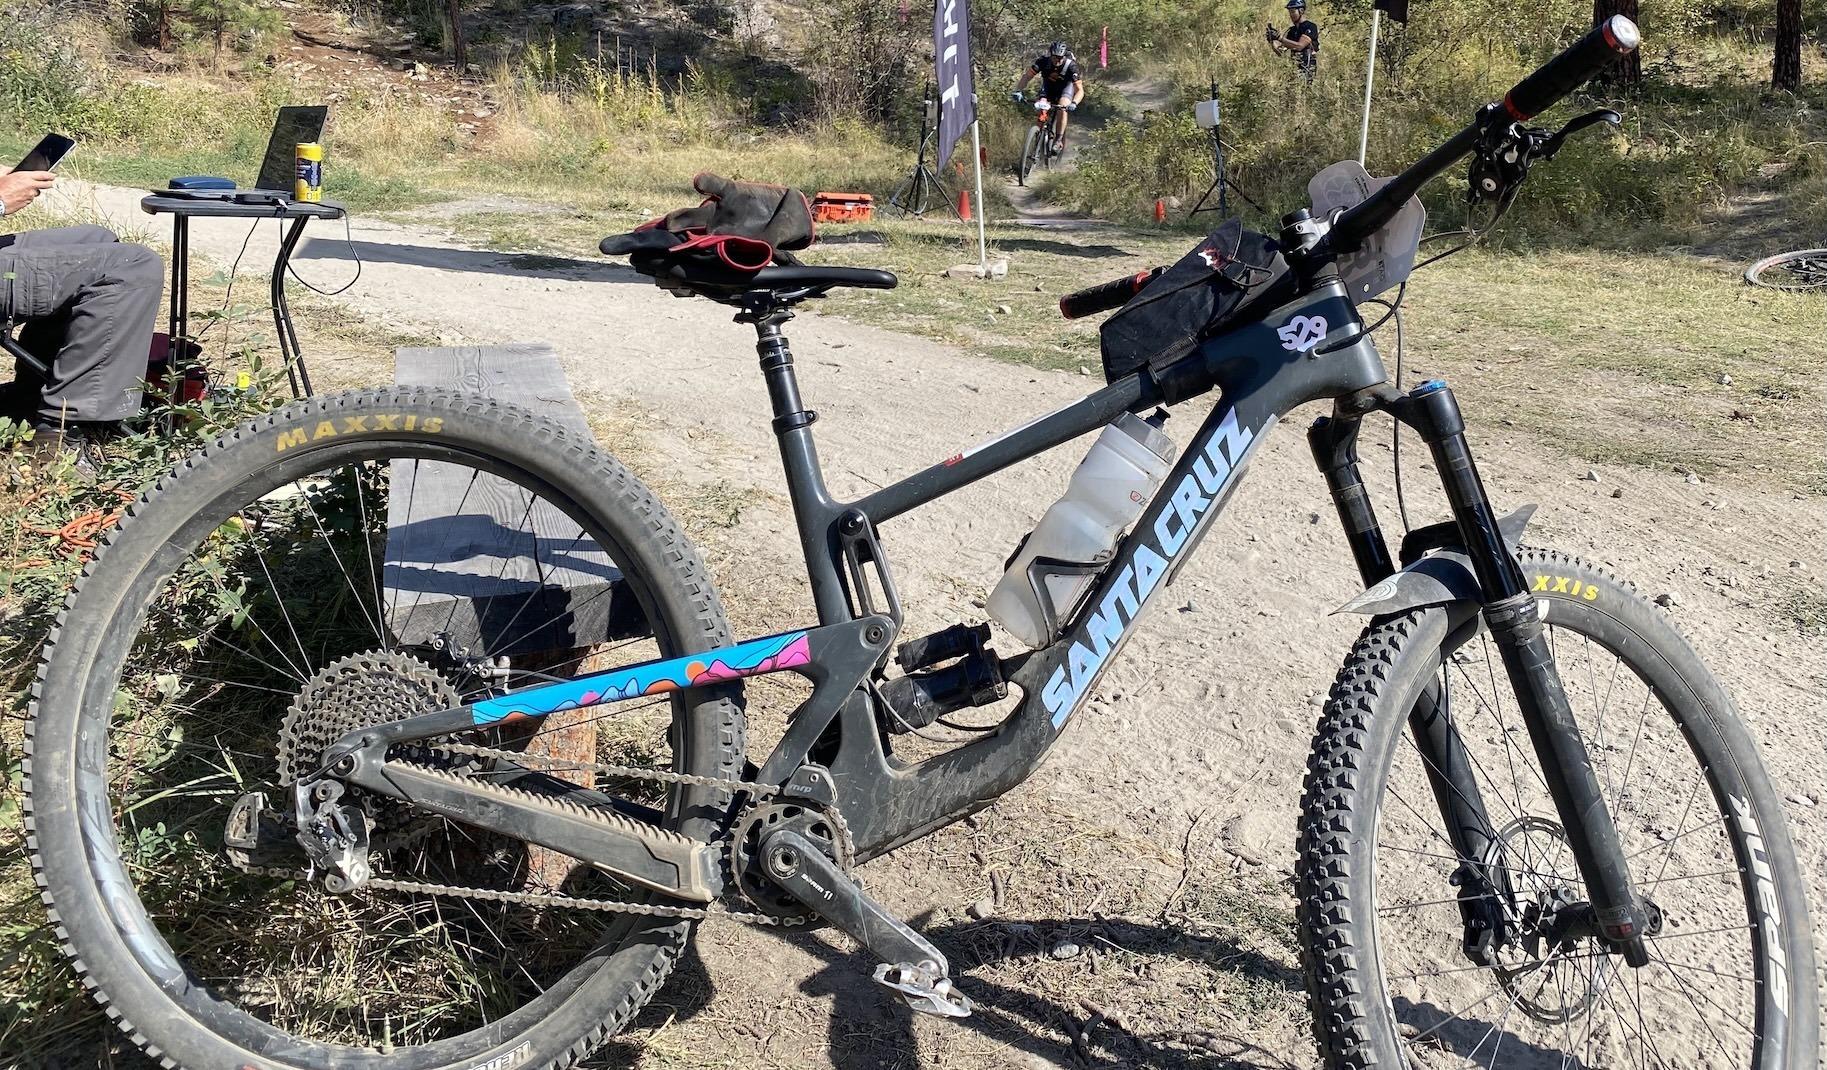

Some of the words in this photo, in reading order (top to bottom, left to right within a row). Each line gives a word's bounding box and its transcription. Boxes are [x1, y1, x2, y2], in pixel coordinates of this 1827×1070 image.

[1277, 315, 1328, 352] 529
[277, 414, 444, 451] MAXXIS
[1531, 575, 1600, 601] XXIS
